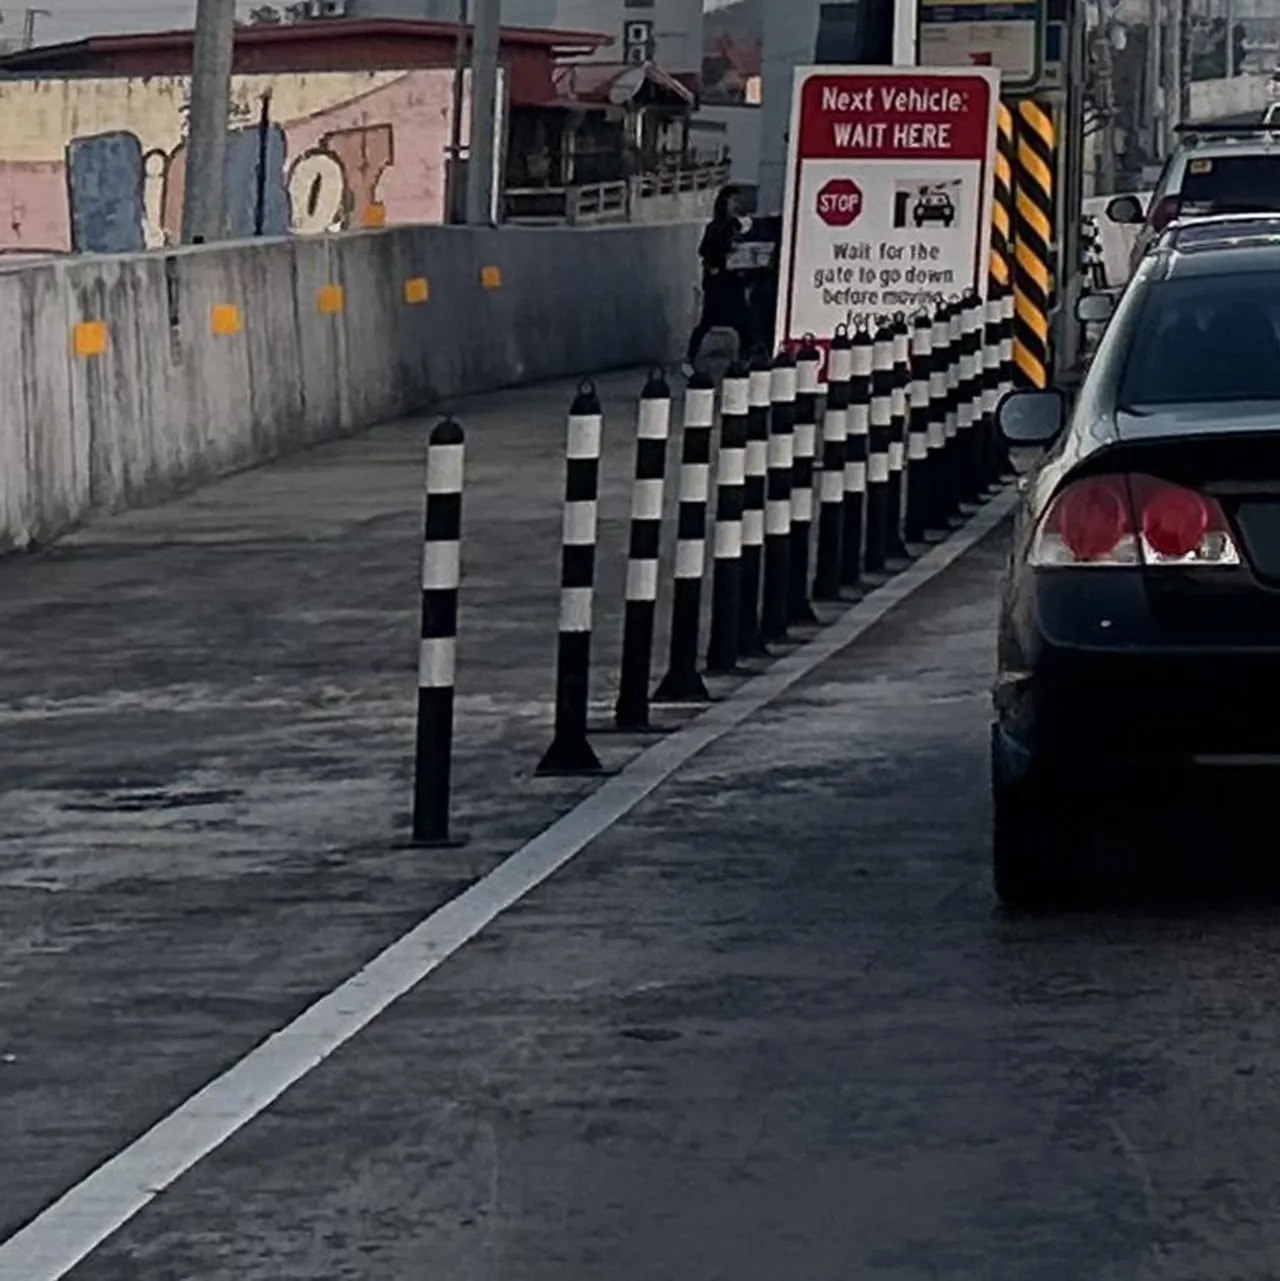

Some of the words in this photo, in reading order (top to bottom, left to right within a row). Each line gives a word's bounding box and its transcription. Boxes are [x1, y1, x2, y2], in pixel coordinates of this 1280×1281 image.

[821, 86, 874, 111] Next
[880, 87, 969, 113] Vehicle:
[833, 123, 887, 148] WAIT
[893, 123, 951, 148] HERE
[819, 193, 859, 212] STOP
[832, 242, 873, 261] Wait
[878, 242, 905, 261] for
[909, 242, 940, 261] the
[813, 267, 853, 289] gate
[859, 267, 877, 284] to
[879, 271, 901, 288] go
[904, 266, 954, 284] down
[821, 288, 879, 306] before
